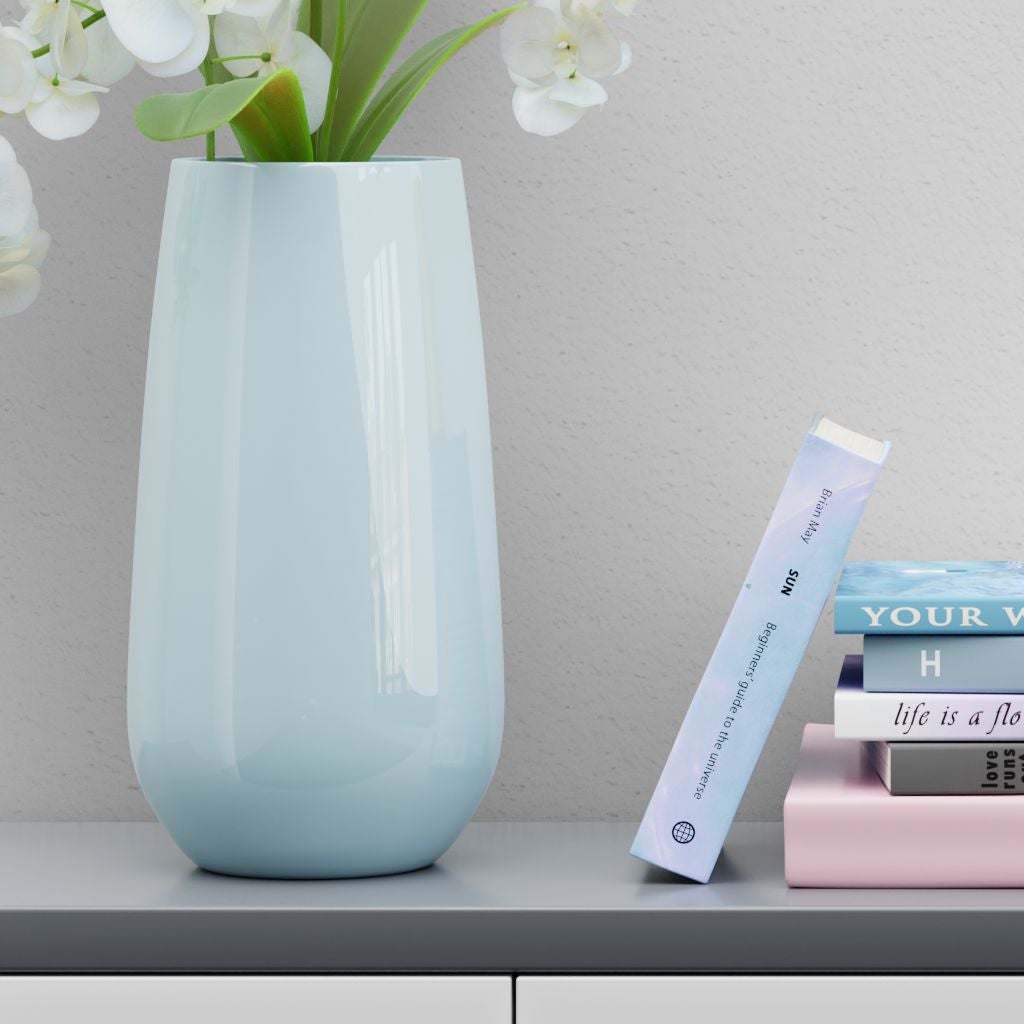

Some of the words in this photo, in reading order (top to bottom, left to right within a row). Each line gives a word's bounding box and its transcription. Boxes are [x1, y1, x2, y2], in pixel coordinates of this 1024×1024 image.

[812, 488, 833, 518] Brian
[800, 520, 820, 544] May
[780, 568, 799, 597] SUN
[860, 606, 989, 627] YOUR
[729, 680, 749, 714] guide
[723, 716, 735, 729] to
[893, 702, 930, 735] life
[940, 705, 959, 726] is
[968, 711, 983, 726] a
[714, 731, 729, 751] the
[693, 753, 719, 800] universe
[981, 750, 999, 788] love
[1003, 749, 1016, 790] runs
